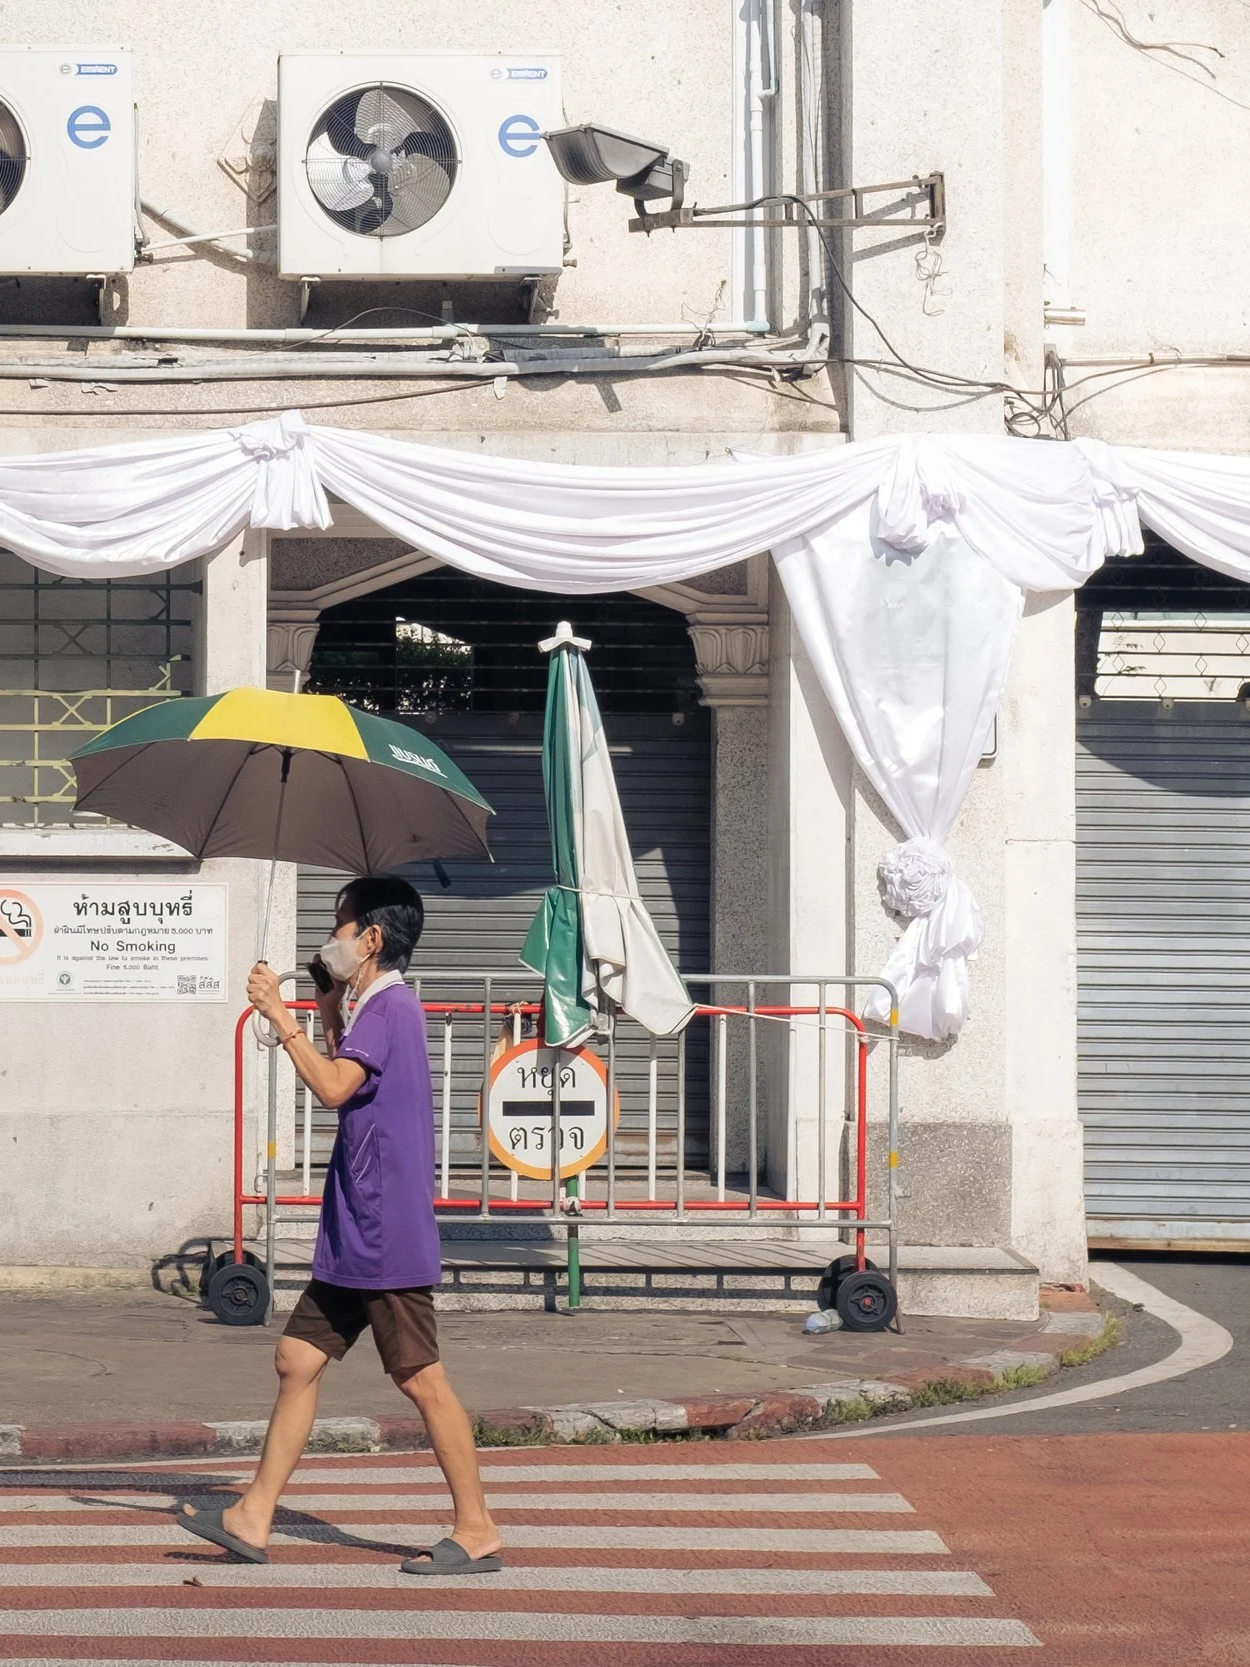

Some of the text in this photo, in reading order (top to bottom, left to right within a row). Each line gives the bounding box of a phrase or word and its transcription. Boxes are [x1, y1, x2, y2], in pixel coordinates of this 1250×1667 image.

[73, 889, 193, 925] ห้ามสูบบุหรี่
[90, 940, 176, 954] No Smoking
